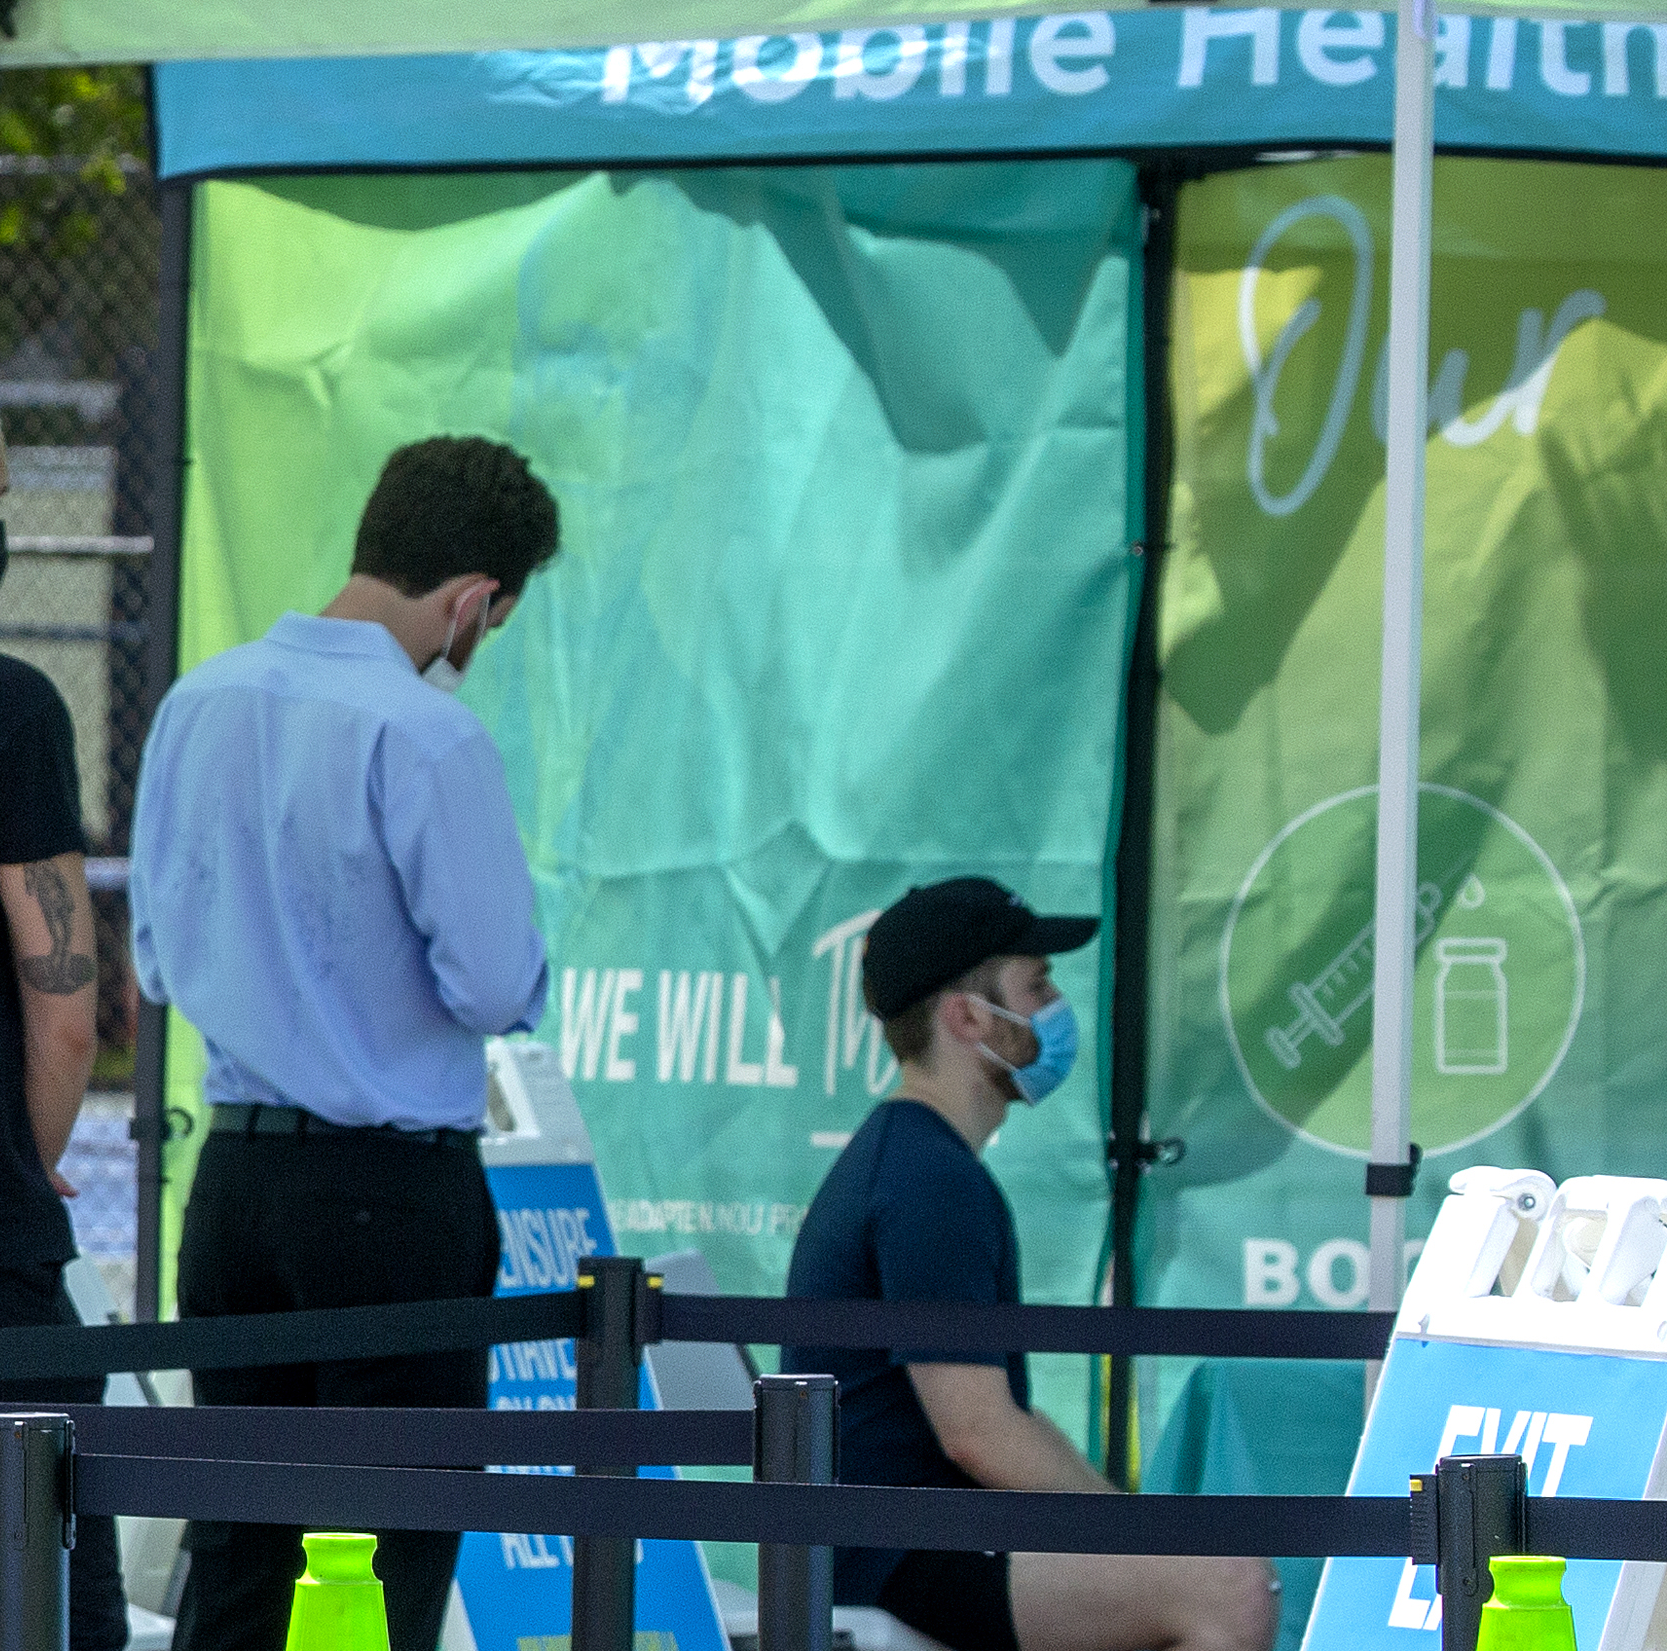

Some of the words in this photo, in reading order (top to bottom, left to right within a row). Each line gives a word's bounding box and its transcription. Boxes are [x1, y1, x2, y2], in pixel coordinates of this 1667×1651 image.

[602, 10, 1115, 102] Mobile
[561, 967, 643, 1082] WE
[657, 969, 799, 1088] WILL
